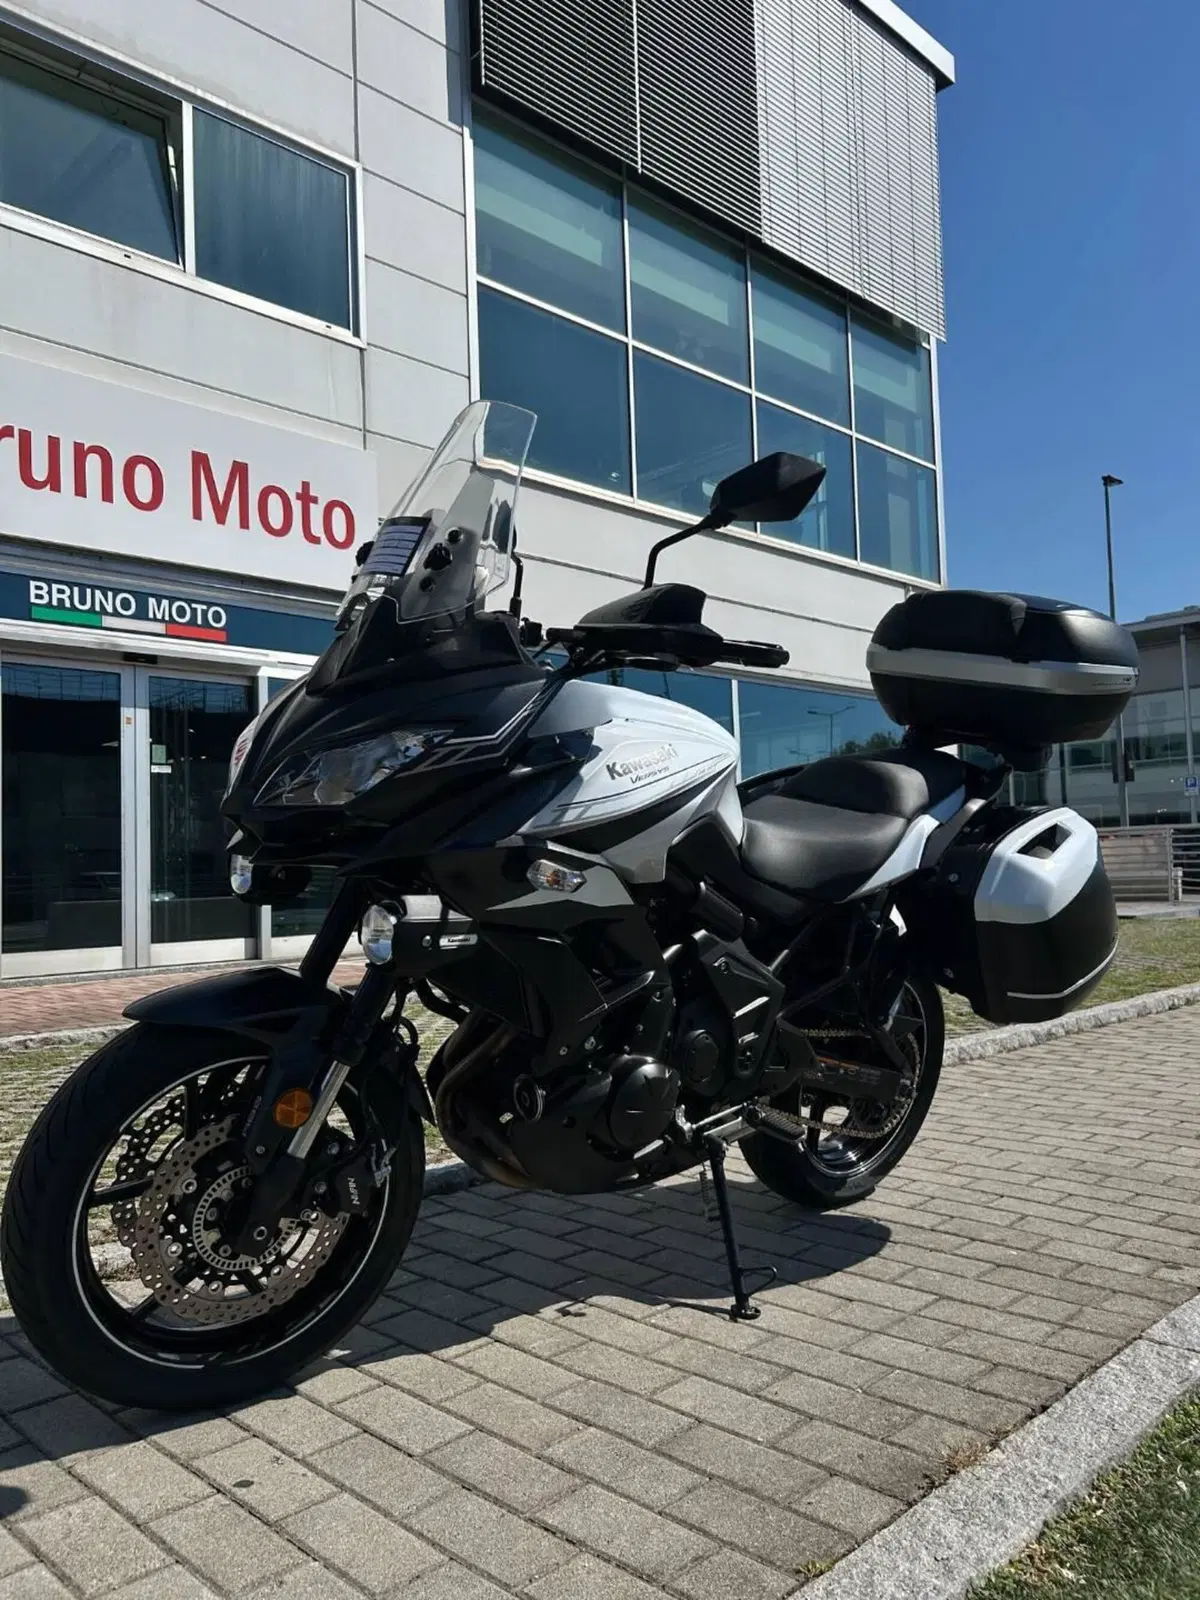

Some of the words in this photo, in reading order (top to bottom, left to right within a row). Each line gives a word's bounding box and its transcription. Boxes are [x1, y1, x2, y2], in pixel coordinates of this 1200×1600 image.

[191, 449, 356, 551] Moto
[29, 580, 136, 616] BRUNO
[148, 597, 227, 628] MOTO
[606, 743, 679, 780] Kawasaki
